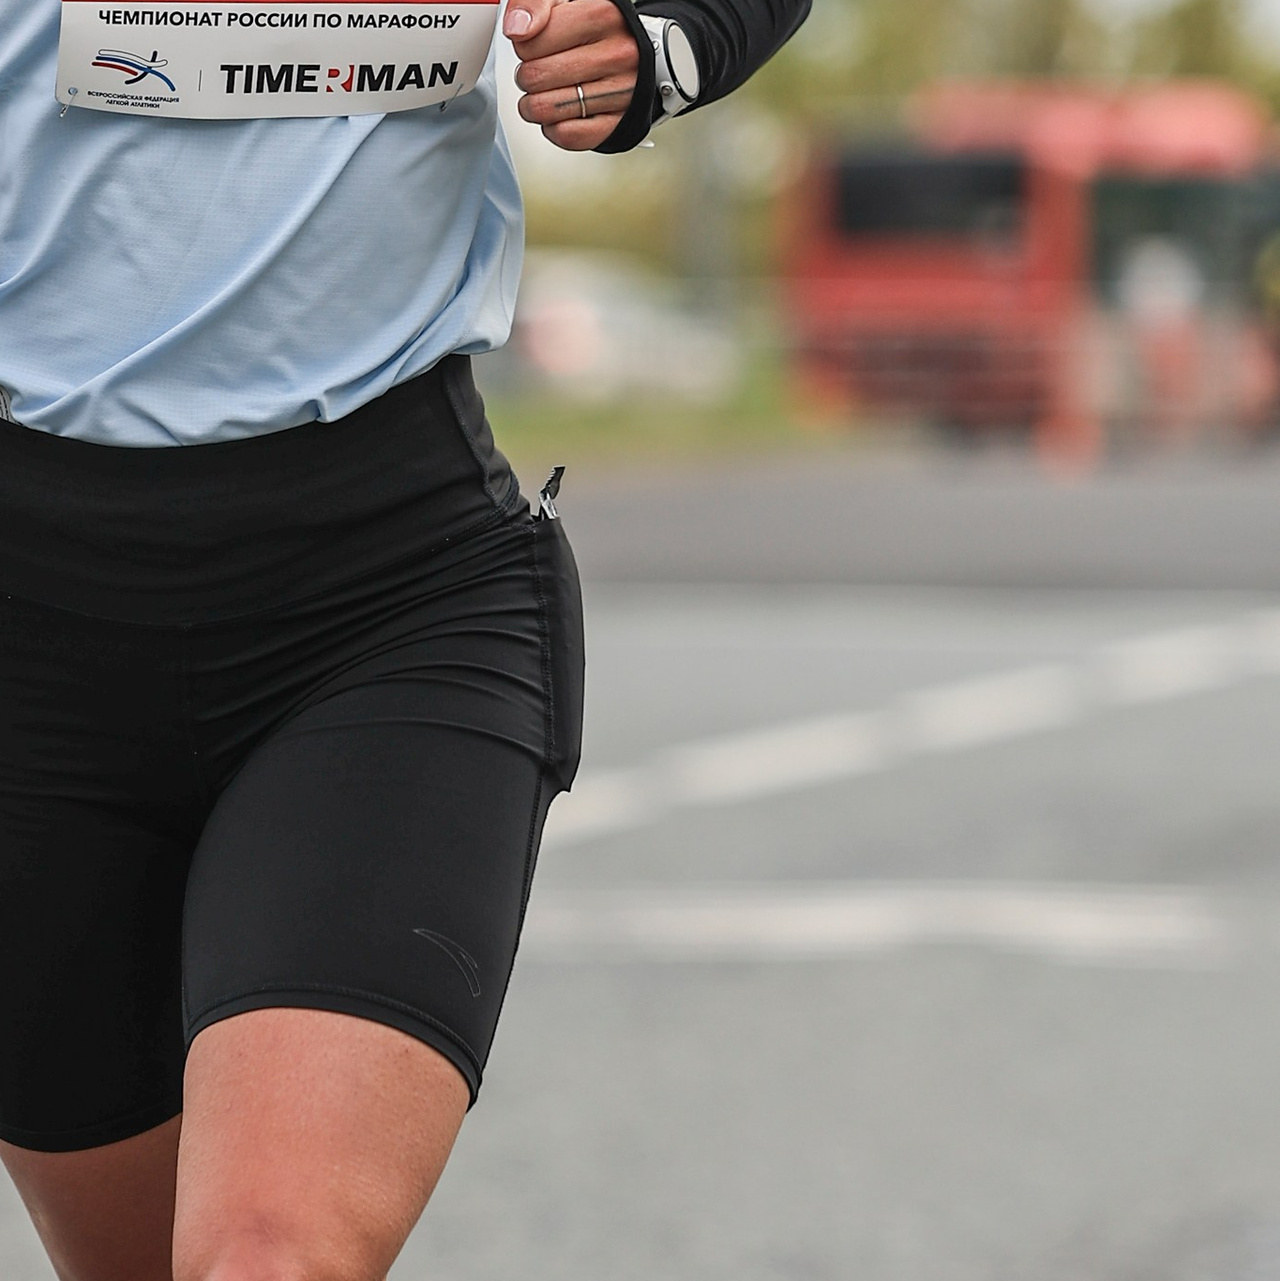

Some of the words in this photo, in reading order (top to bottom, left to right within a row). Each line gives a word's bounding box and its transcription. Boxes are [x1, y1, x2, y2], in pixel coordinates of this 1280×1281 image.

[98, 9, 223, 27] ЧЕМПИОНАТ
[227, 12, 308, 28] РОССИИ
[312, 13, 342, 29] ПО
[346, 13, 461, 29] МАРАФОНУ
